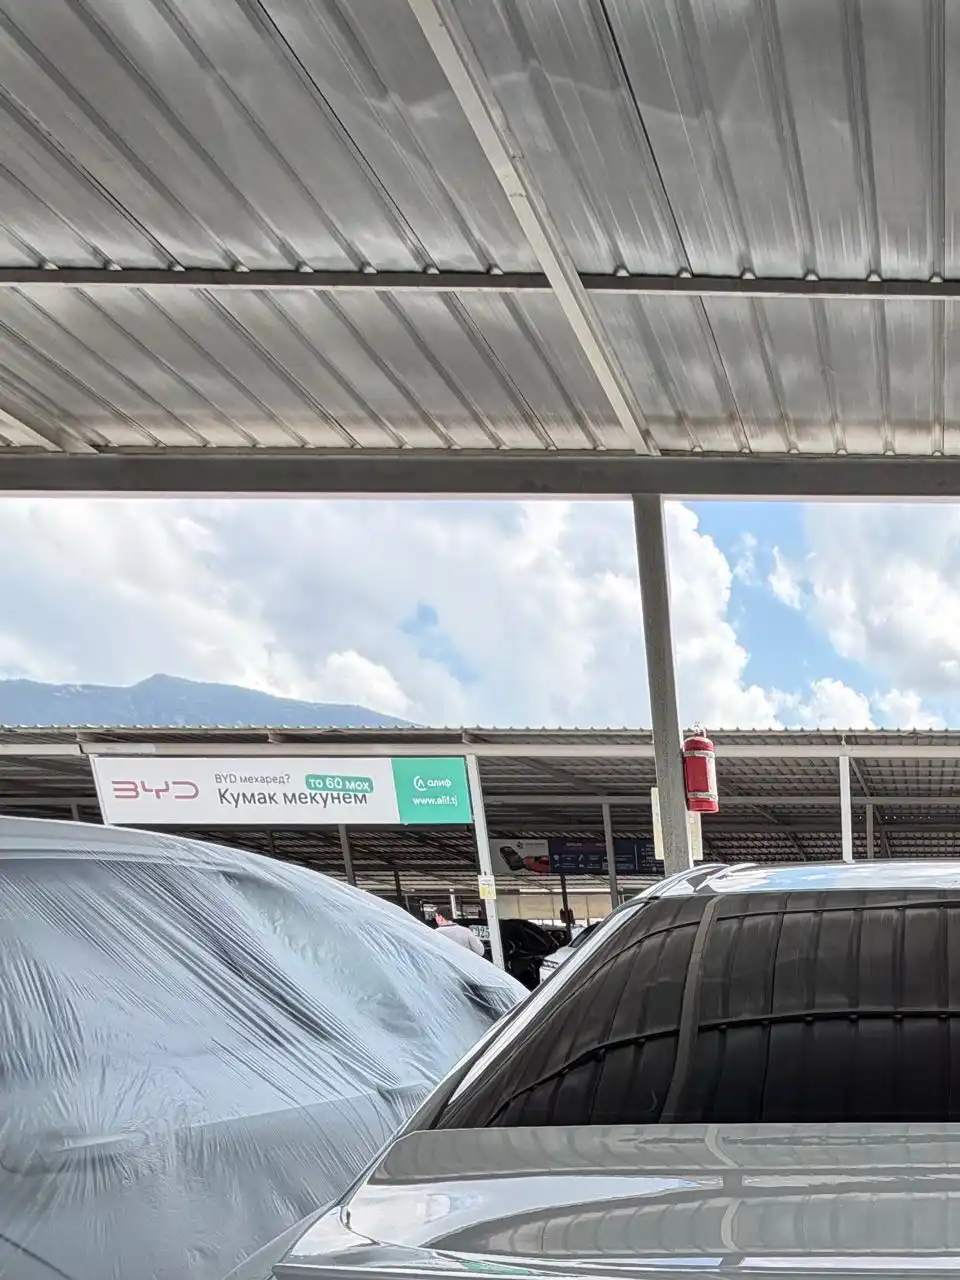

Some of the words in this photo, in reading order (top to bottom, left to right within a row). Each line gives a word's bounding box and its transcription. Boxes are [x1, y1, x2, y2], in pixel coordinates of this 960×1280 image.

[215, 774, 237, 784] BYD
[239, 774, 290, 786] мехаред?
[309, 779, 323, 788] то
[326, 777, 342, 789] 60
[112, 781, 199, 799] BYD
[217, 788, 278, 808] Кумак
[284, 791, 367, 808] мекунем
[412, 795, 457, 807] www.alif.tj
